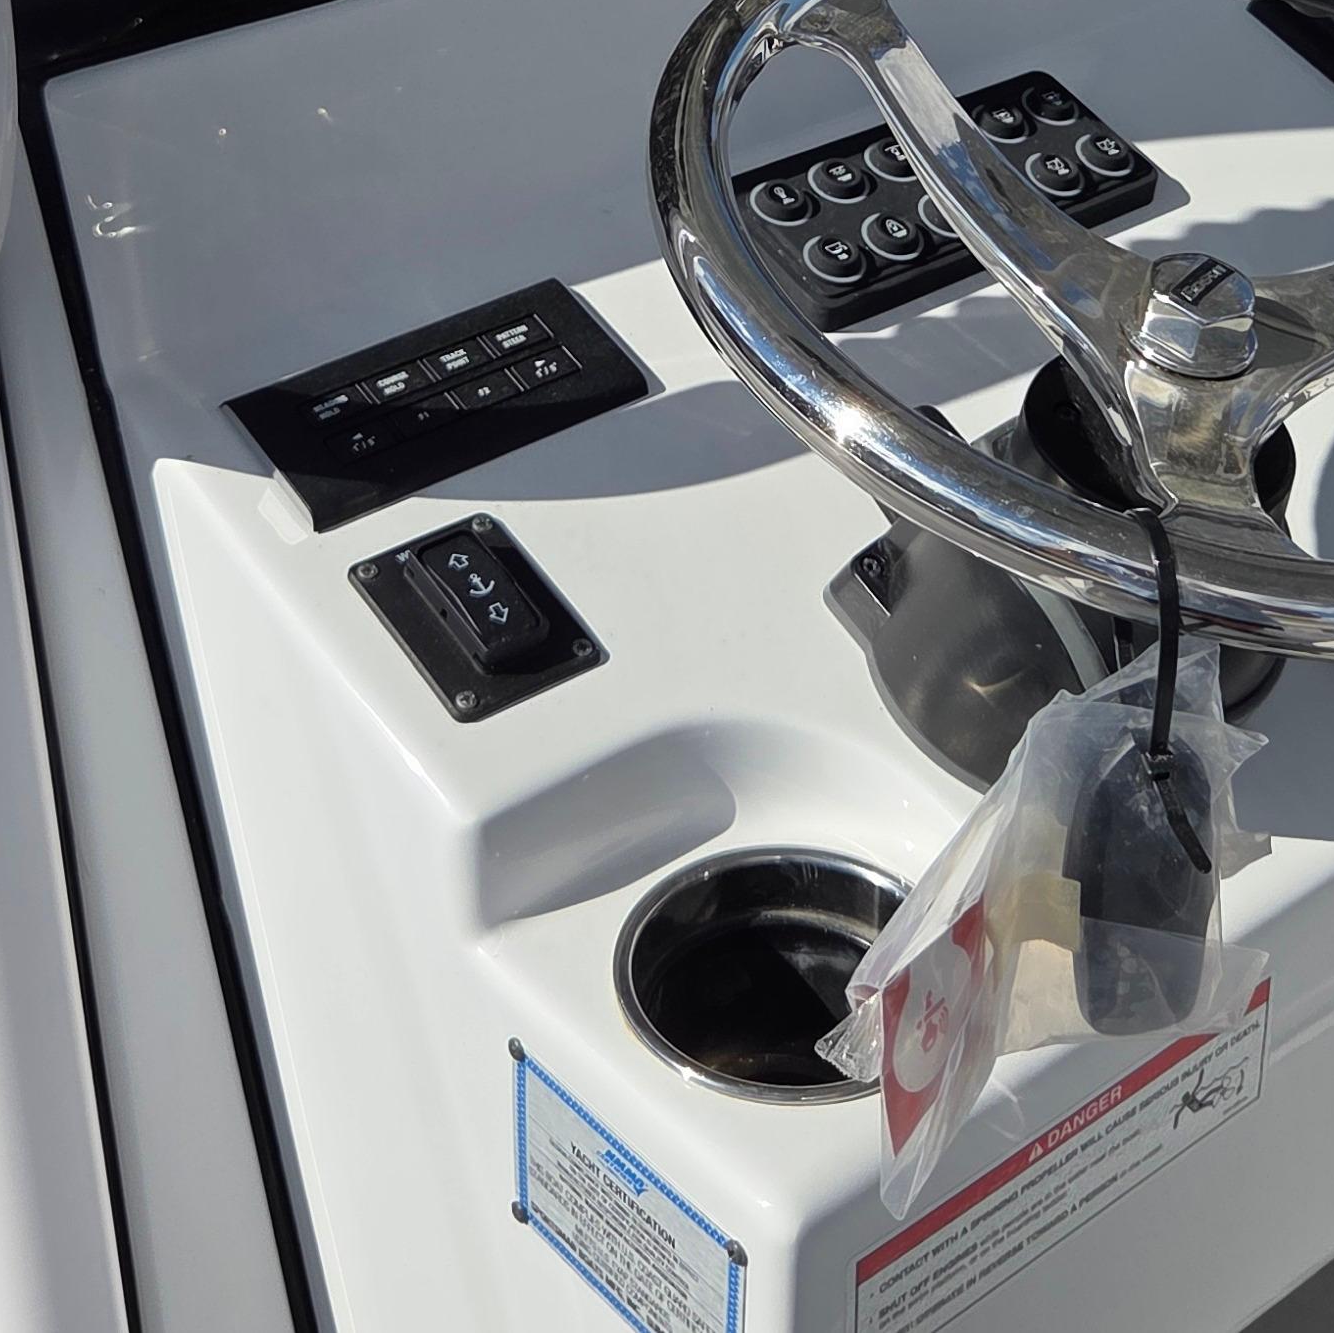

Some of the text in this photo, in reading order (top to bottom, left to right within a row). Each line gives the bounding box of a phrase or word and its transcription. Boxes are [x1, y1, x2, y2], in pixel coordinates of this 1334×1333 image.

[1048, 1084, 1122, 1145] DANGER
[570, 1141, 600, 1177] YACHT
[603, 1173, 676, 1249] CERTIFICATION
[879, 1250, 928, 1294] CONTACT
[931, 1230, 958, 1258] WITH
[1214, 1040, 1228, 1058] OR
[910, 1274, 930, 1298] OFF
